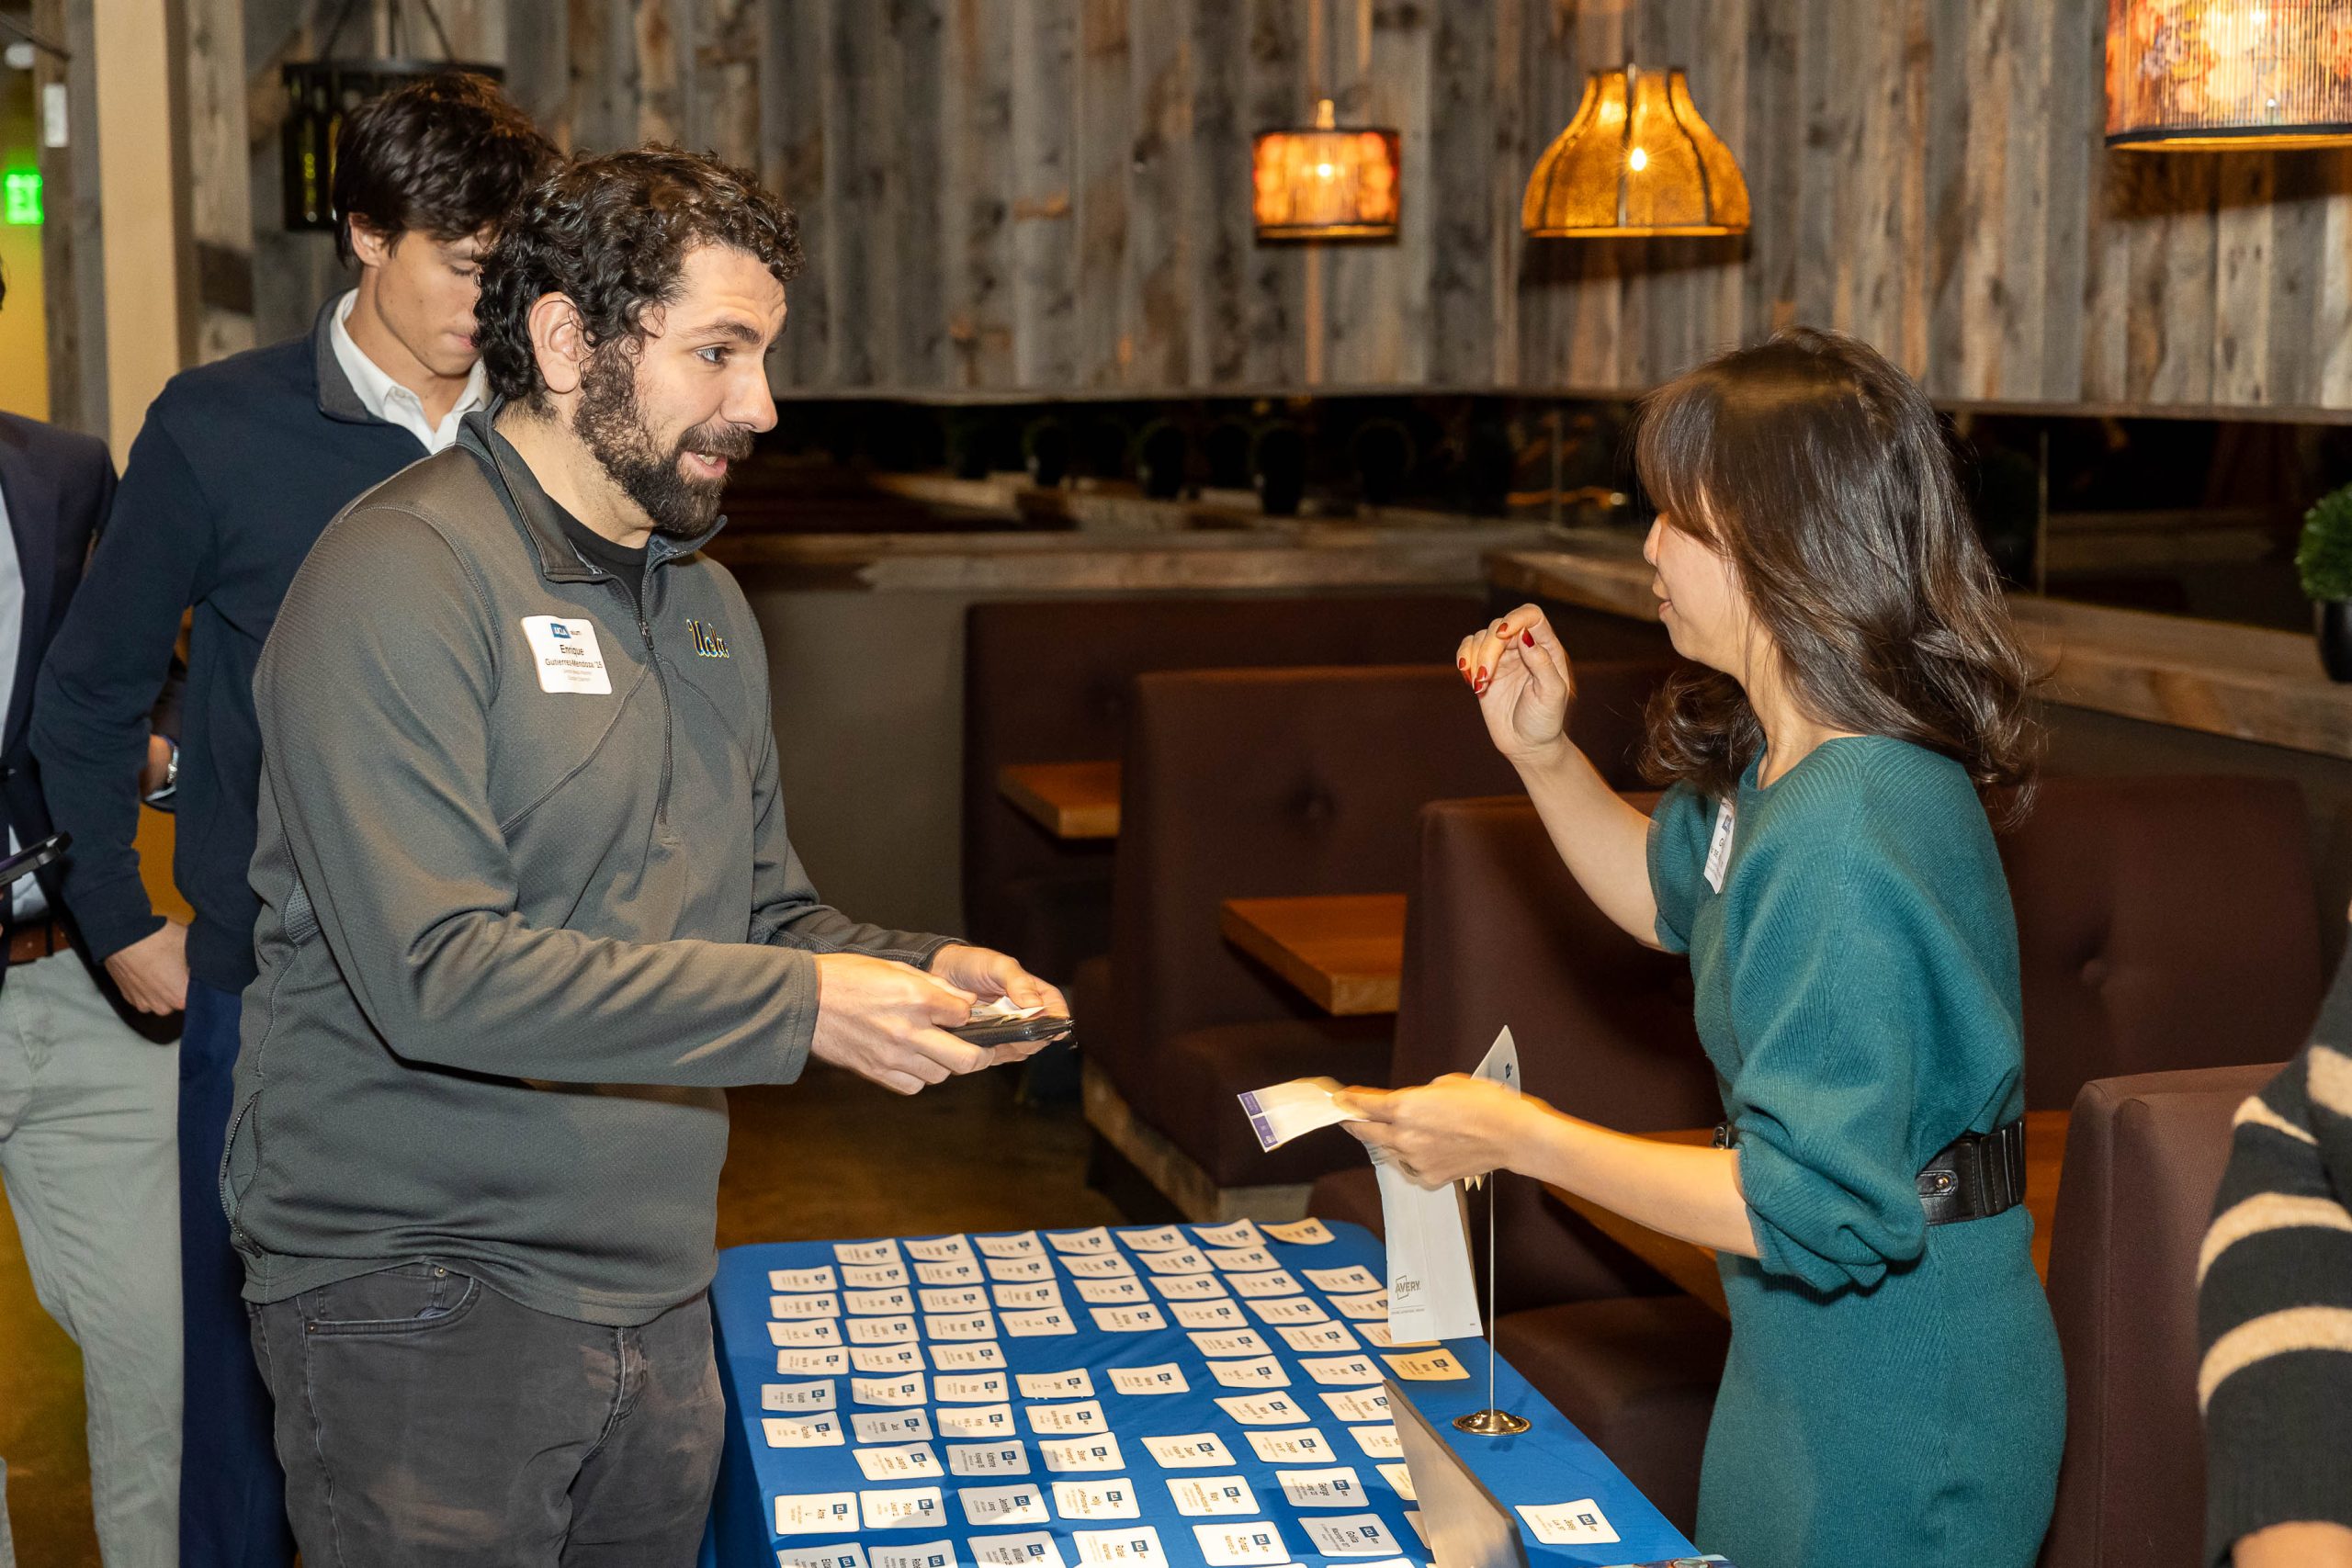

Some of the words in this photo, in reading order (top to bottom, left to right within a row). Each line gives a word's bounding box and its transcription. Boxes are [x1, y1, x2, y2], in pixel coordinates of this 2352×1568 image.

[560, 644, 584, 657] Enrique
[1395, 1280, 1420, 1293] AVERY
[999, 1498, 1012, 1514] Jennifer
[817, 1508, 826, 1519] Anne
[1012, 1548, 1024, 1564] William
